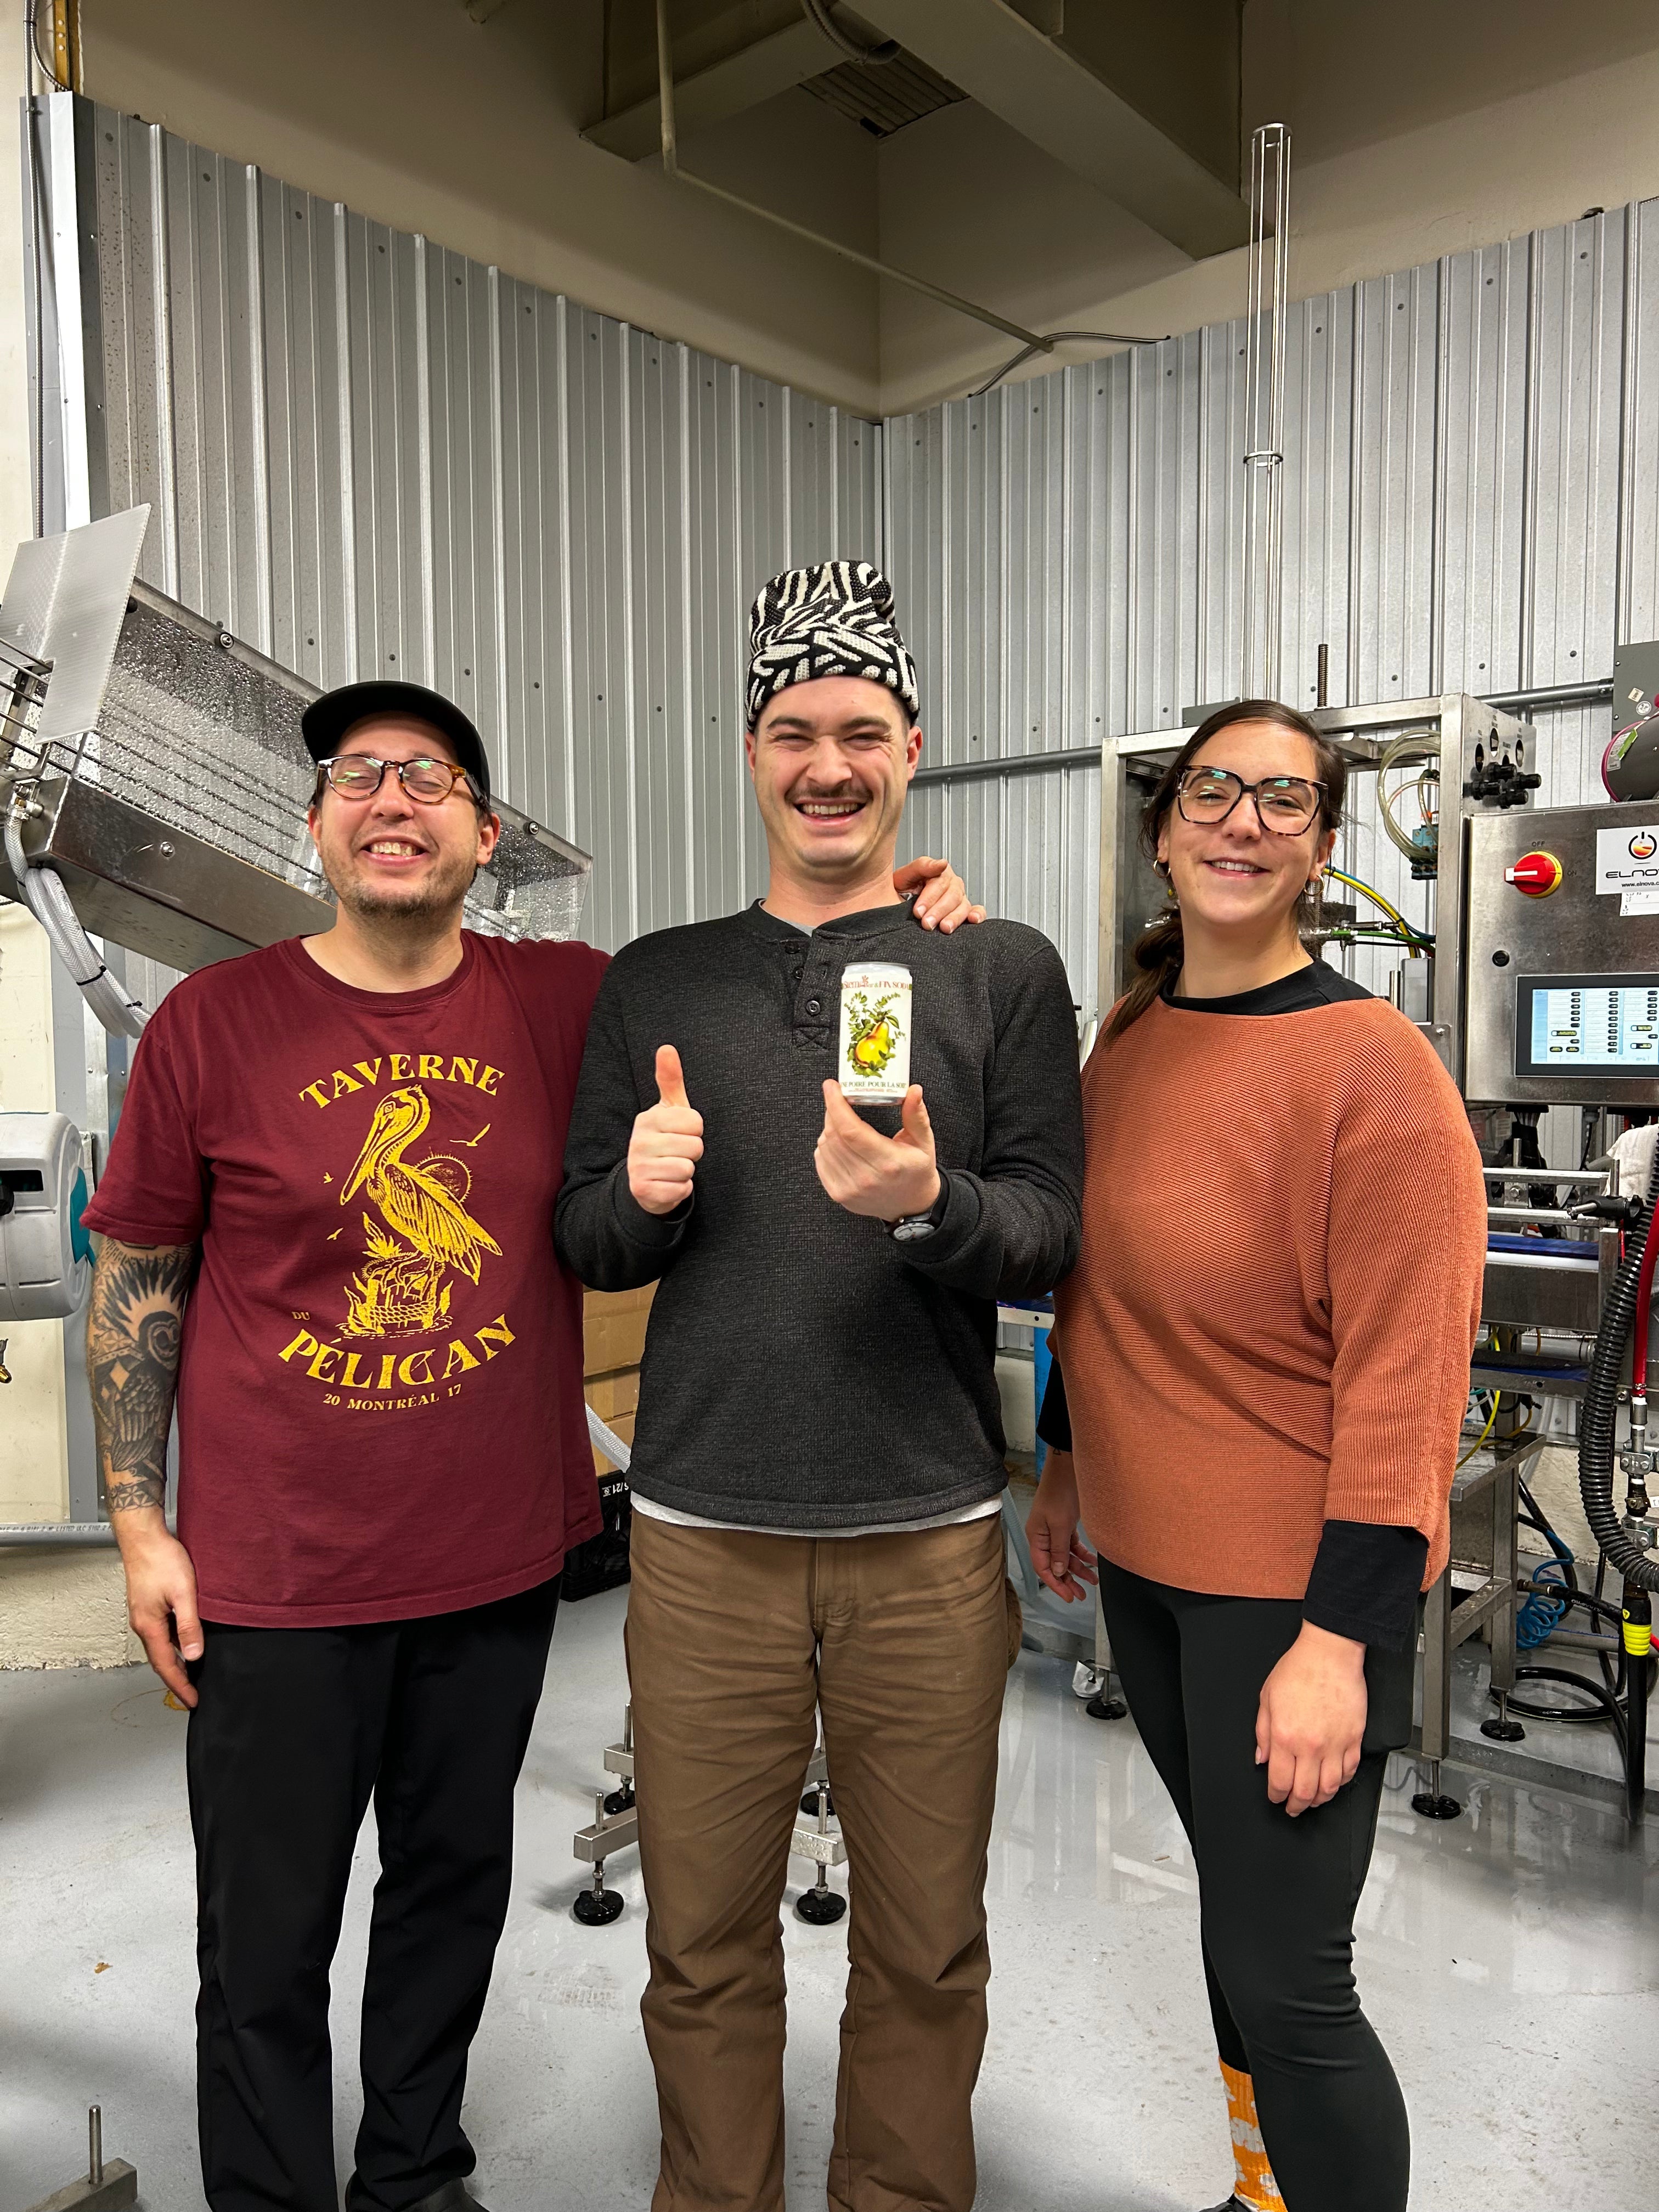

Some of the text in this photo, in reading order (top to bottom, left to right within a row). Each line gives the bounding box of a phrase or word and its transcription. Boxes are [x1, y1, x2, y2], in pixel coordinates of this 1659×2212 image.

[1605, 868, 1659, 879] ELNO
[298, 1053, 505, 1109] TAVERNE
[291, 1311, 311, 1321] DU
[323, 1383, 462, 1411] 20 MONTRÉAL 17
